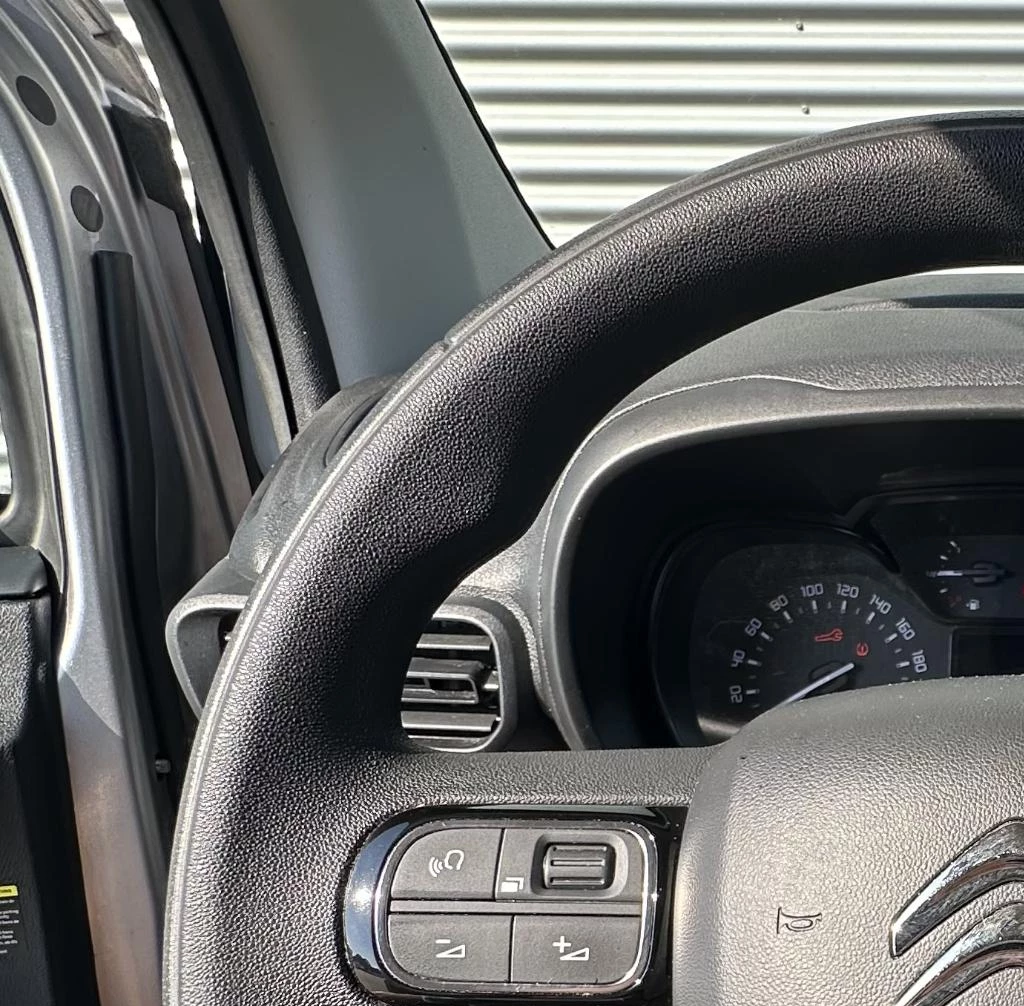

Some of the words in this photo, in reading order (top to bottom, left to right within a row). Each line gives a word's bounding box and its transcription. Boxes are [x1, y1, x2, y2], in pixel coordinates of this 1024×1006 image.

[801, 583, 824, 598] 100
[836, 583, 860, 599] 120
[769, 594, 788, 612] 80
[869, 594, 892, 615] 140
[745, 618, 762, 637] 60
[896, 617, 915, 641] 160
[731, 649, 745, 668] 40
[911, 649, 927, 673] 180
[729, 685, 743, 704] 20
